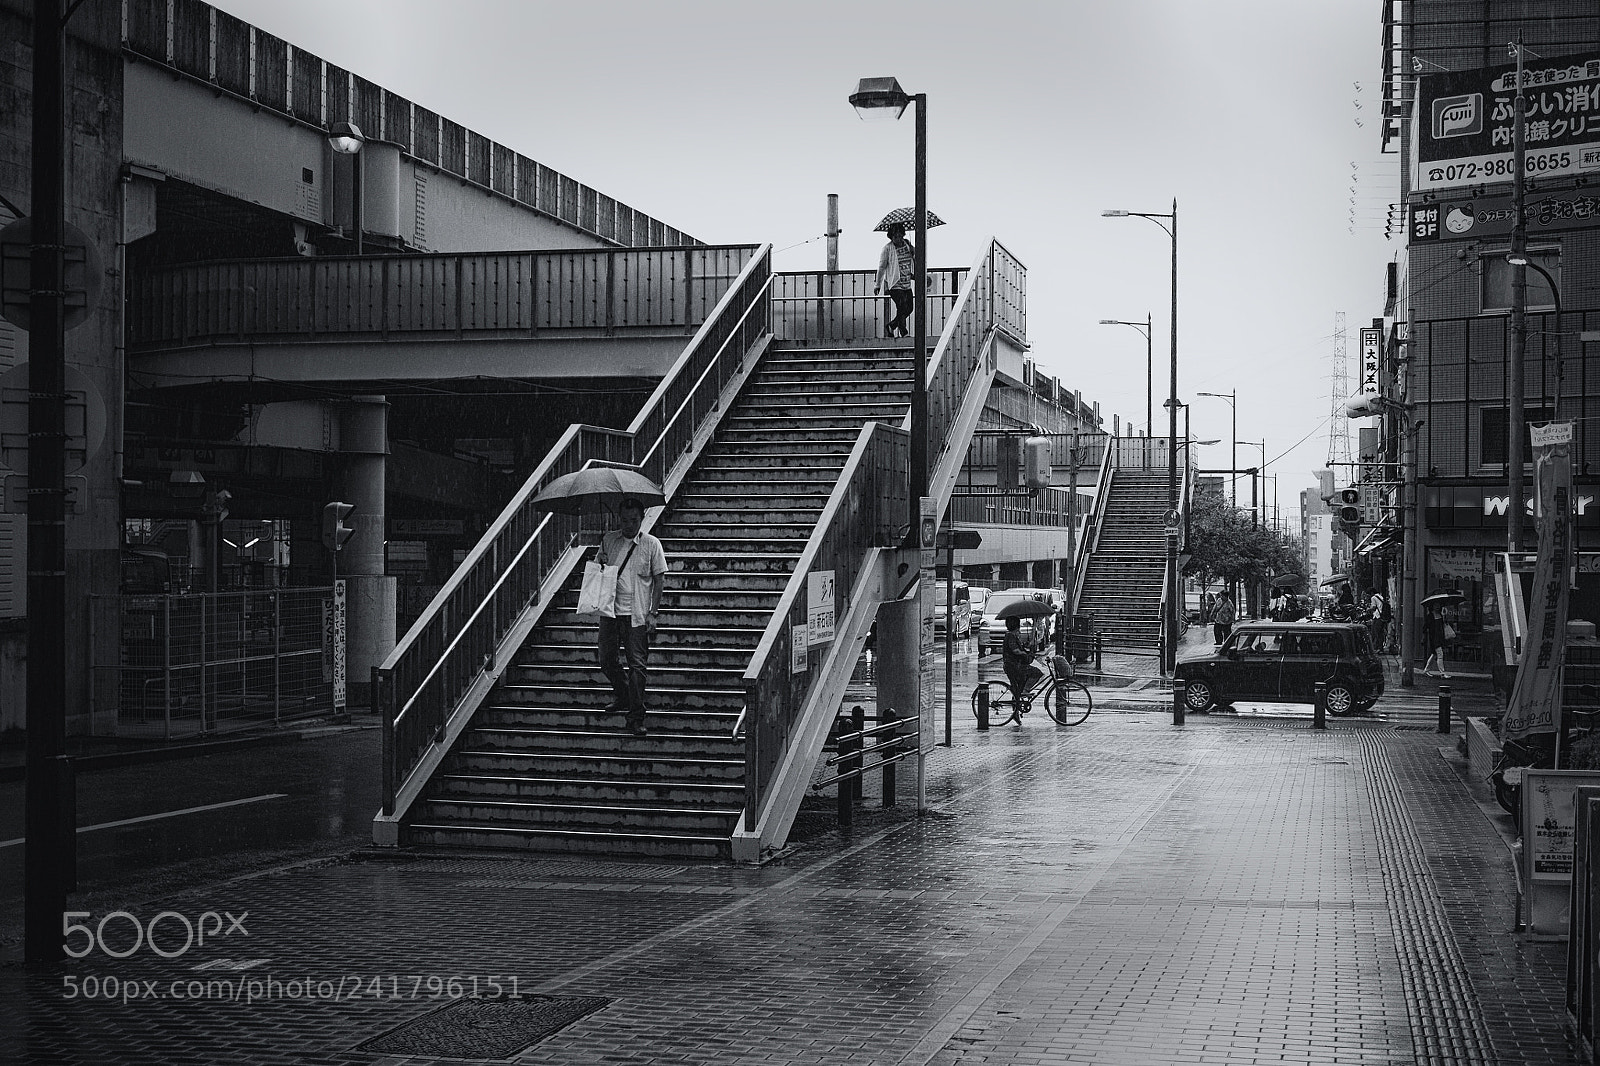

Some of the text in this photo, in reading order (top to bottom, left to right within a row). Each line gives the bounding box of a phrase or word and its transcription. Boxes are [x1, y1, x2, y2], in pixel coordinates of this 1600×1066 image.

[1446, 151, 1571, 181] 072-9806655
[1414, 208, 1438, 223] 受付
[1415, 224, 1437, 237] 3F
